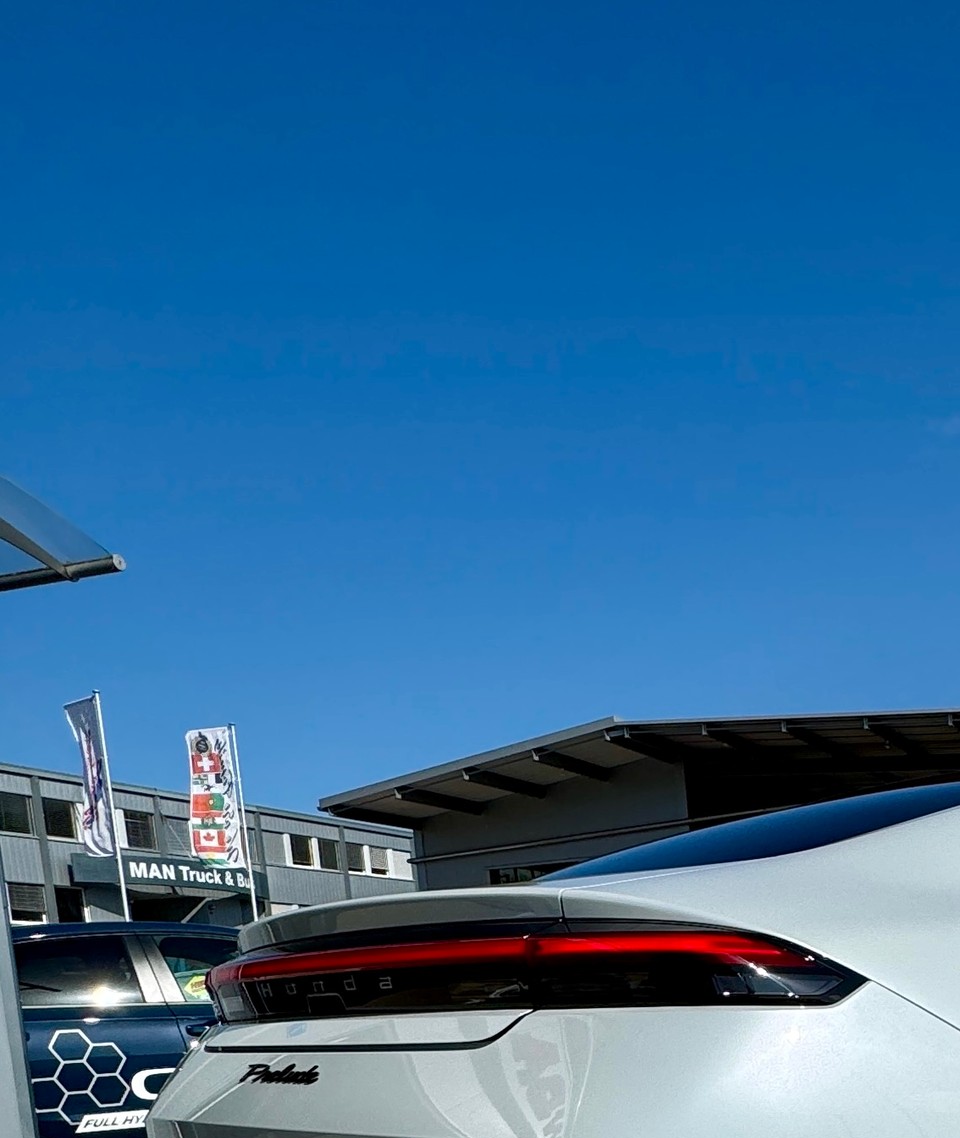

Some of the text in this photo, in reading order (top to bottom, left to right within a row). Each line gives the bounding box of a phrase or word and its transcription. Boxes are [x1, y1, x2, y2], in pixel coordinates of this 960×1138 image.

[129, 861, 255, 889] MAN Truck & Bu
[260, 976, 393, 998] Honda
[238, 1063, 320, 1086] Prelude
[83, 1114, 146, 1129] FULL HY
